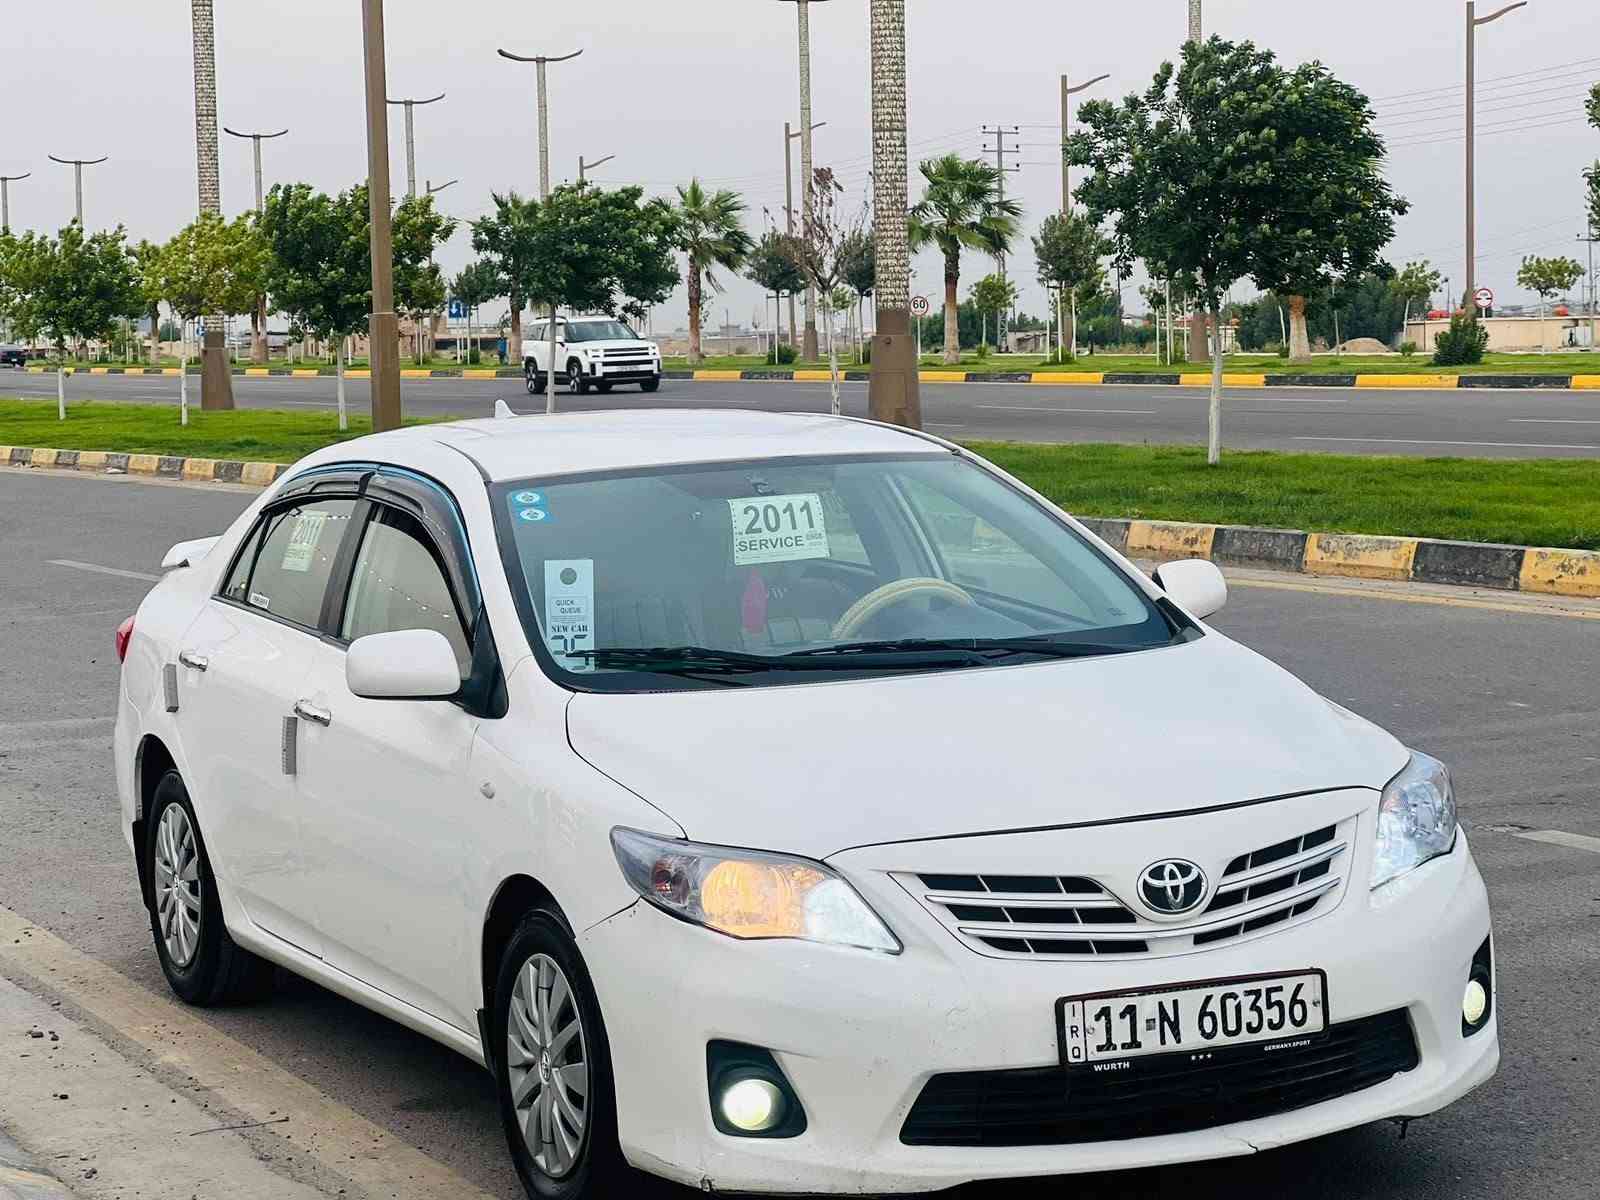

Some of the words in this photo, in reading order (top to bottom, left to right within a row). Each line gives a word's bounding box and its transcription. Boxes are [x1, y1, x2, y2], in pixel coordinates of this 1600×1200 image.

[913, 299, 926, 309] 60
[743, 501, 815, 535] 2011
[738, 536, 805, 552] SERVICE
[555, 599, 575, 607] QUICK
[551, 625, 568, 633] NEW
[571, 624, 588, 633] CAR
[1198, 983, 1308, 1041] 60356
[1093, 1061, 1130, 1072] WURTH
